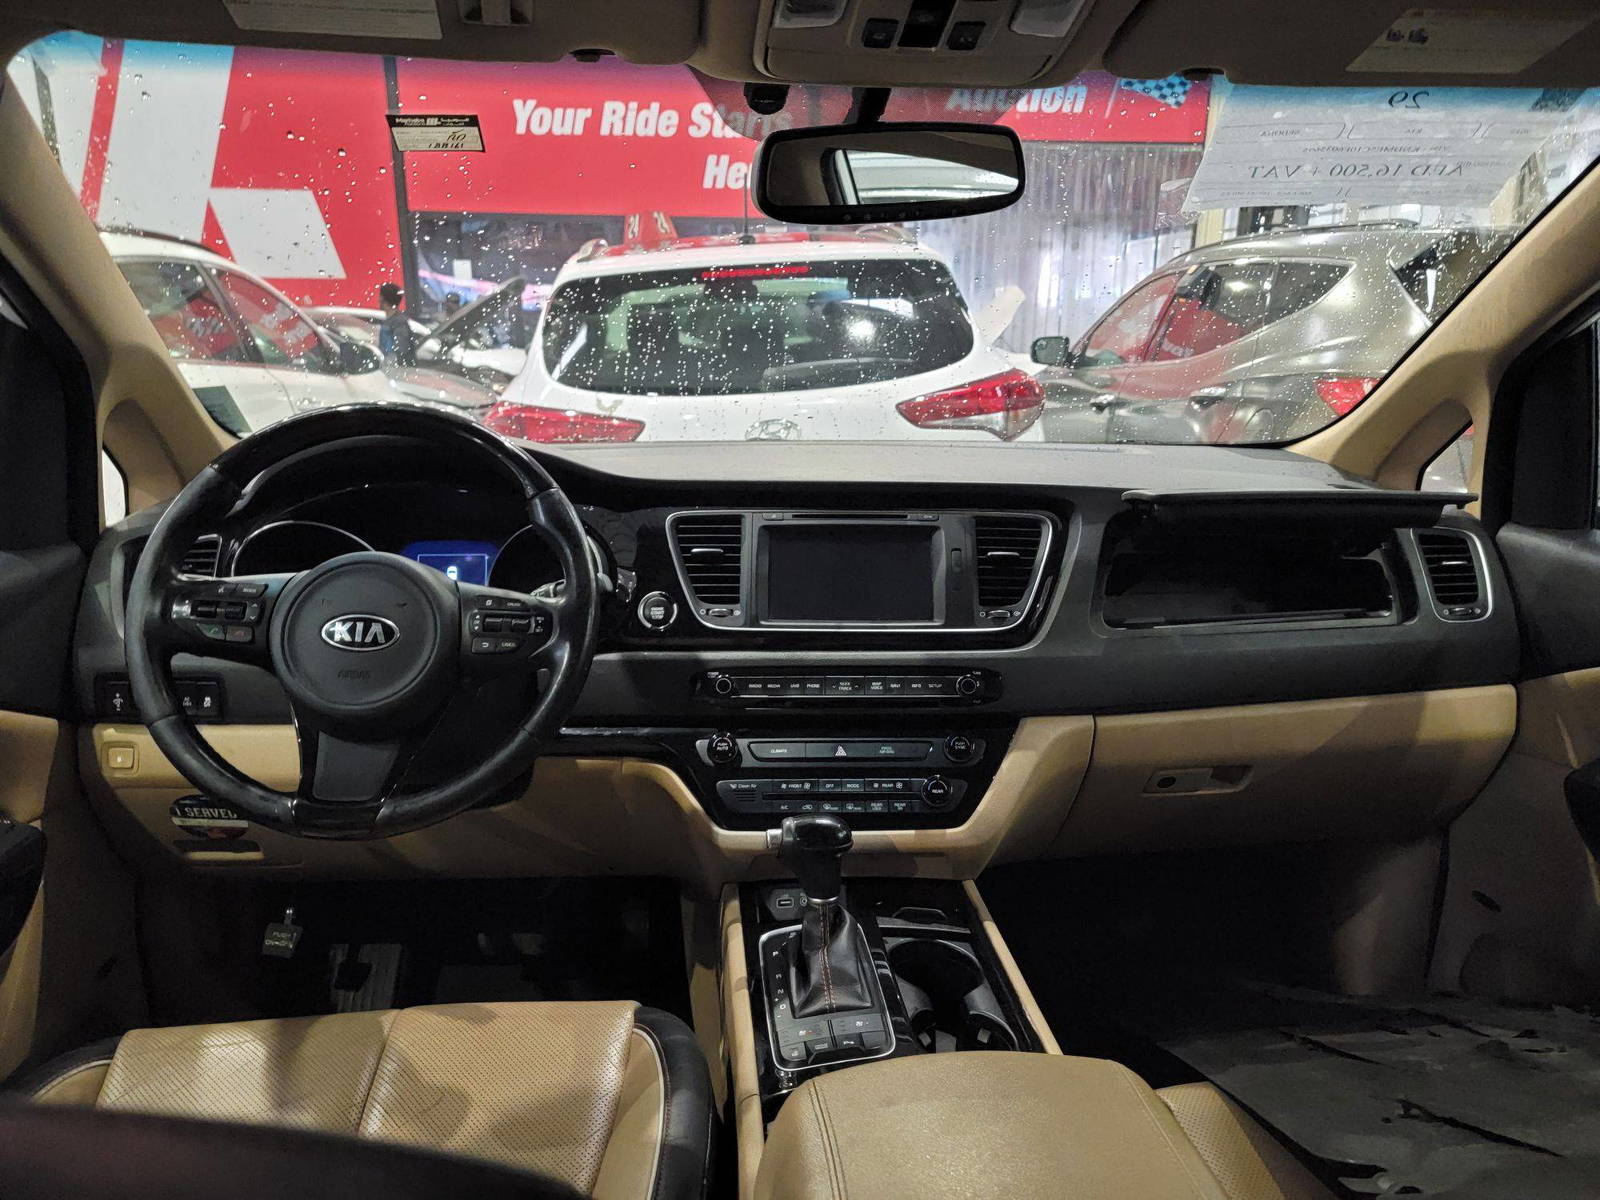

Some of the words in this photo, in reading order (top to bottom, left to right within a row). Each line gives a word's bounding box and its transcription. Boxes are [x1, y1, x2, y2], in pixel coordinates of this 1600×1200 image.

[943, 85, 1089, 113] Auction
[512, 98, 592, 136] Your
[600, 100, 680, 137] Ride
[333, 621, 386, 643] KIA
